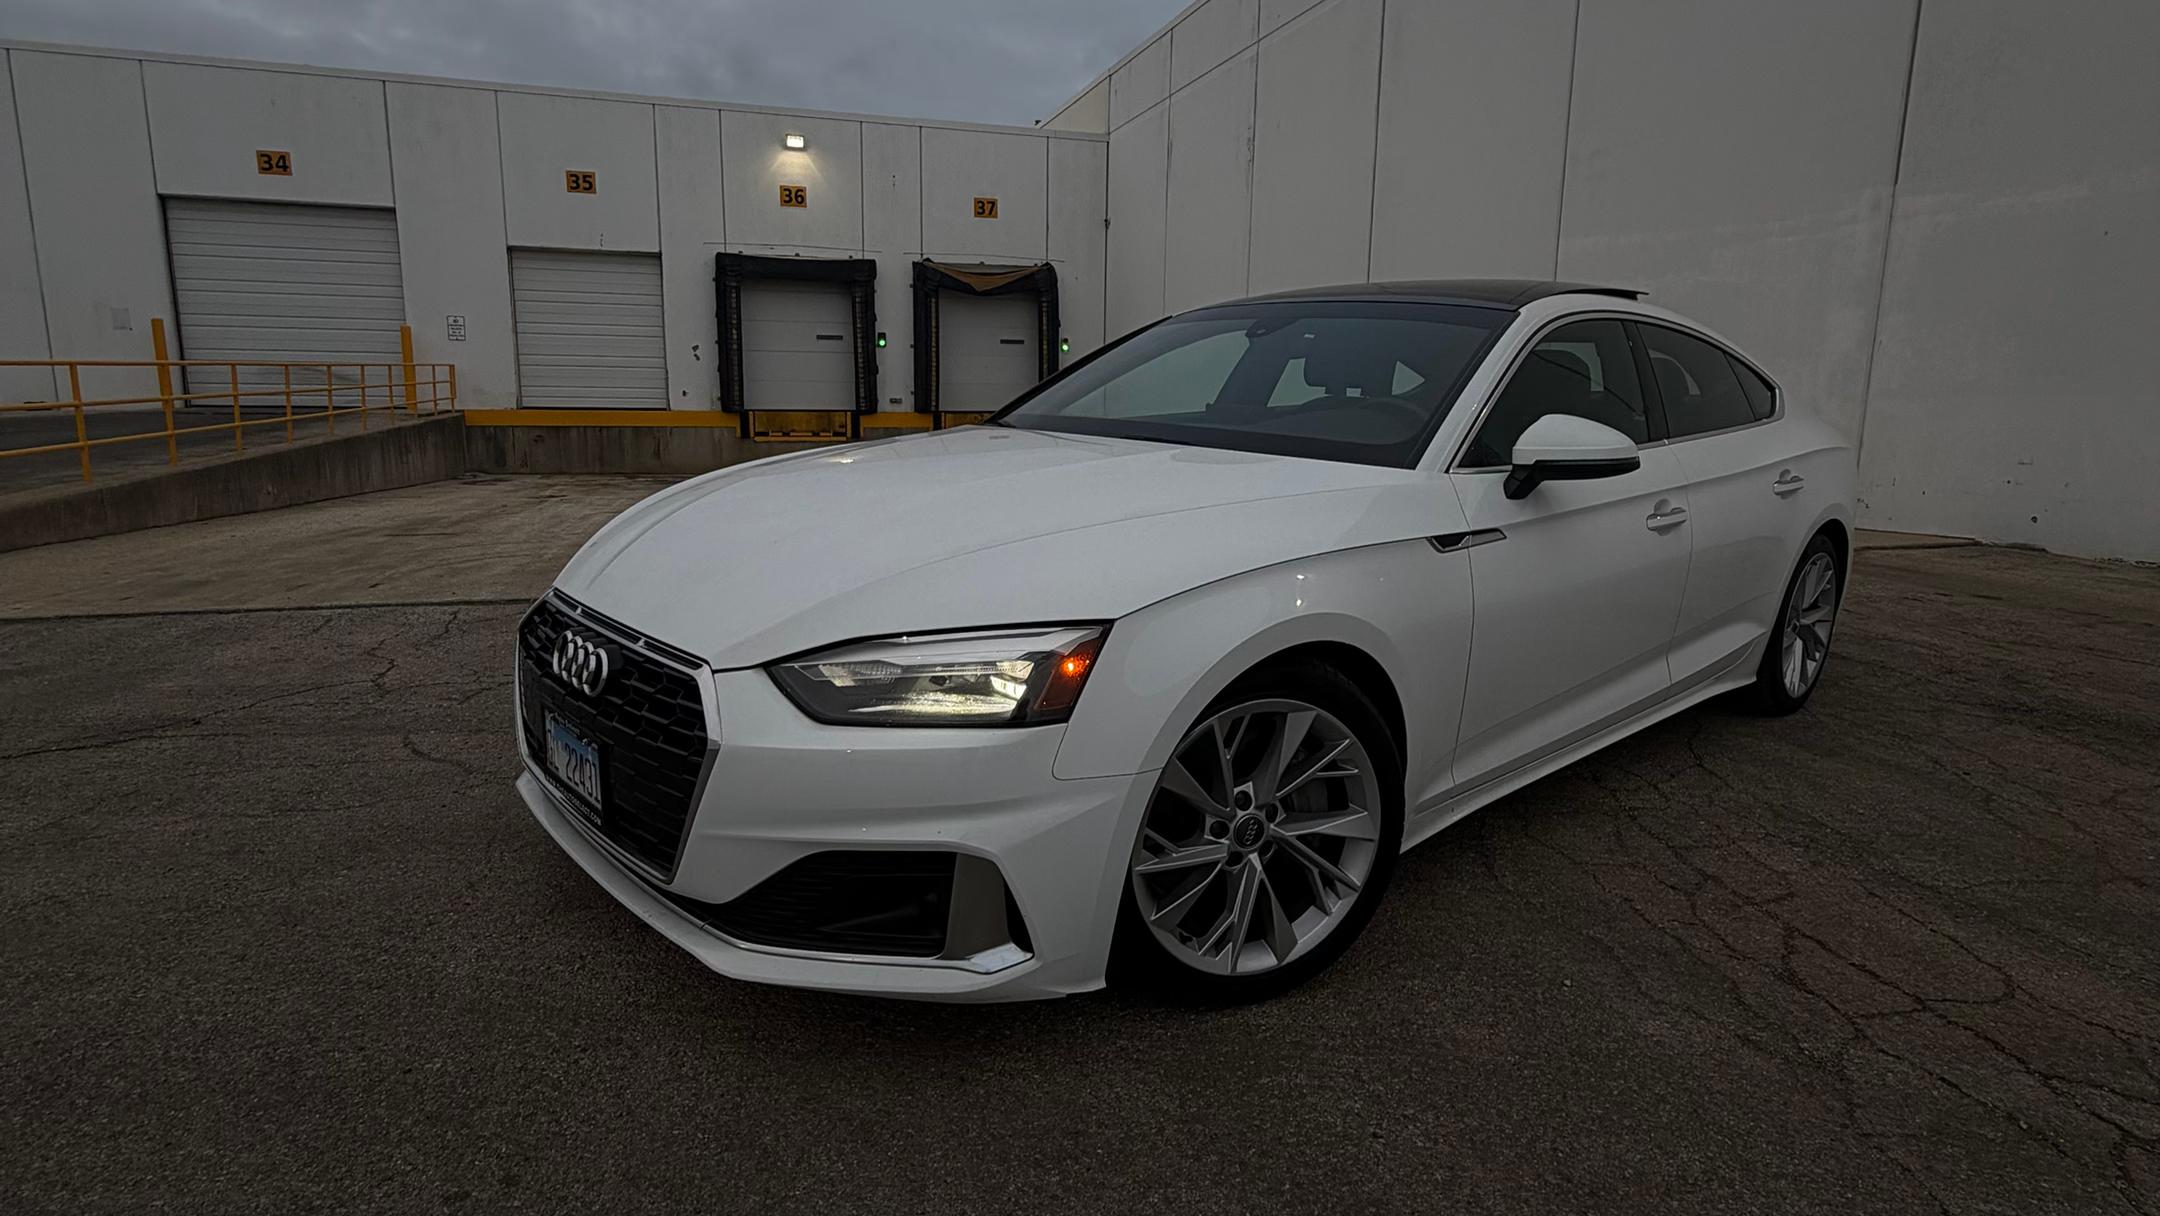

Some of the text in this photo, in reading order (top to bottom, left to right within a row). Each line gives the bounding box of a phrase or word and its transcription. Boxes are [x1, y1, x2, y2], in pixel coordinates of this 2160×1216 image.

[260, 153, 289, 172] 34
[569, 173, 593, 190] 35
[783, 188, 804, 204] 36
[976, 200, 995, 216] 37
[565, 742, 601, 804] 22431
